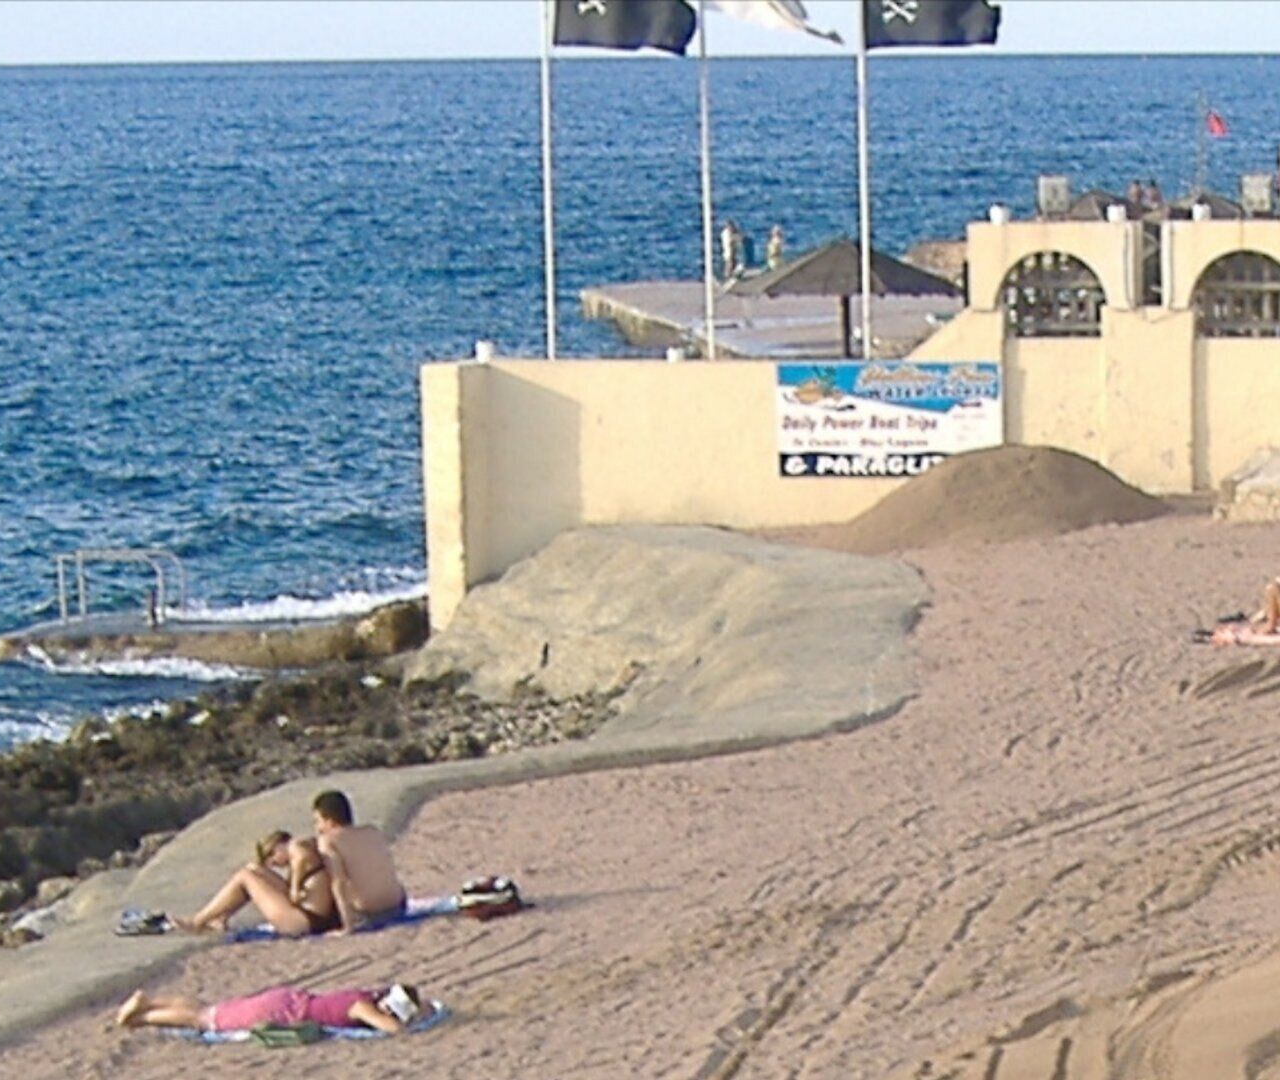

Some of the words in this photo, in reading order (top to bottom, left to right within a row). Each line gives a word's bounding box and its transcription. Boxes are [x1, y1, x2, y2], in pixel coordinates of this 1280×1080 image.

[782, 416, 816, 431] Daily
[822, 416, 863, 430] Power
[870, 416, 900, 430] Boat
[906, 416, 938, 431] Trips
